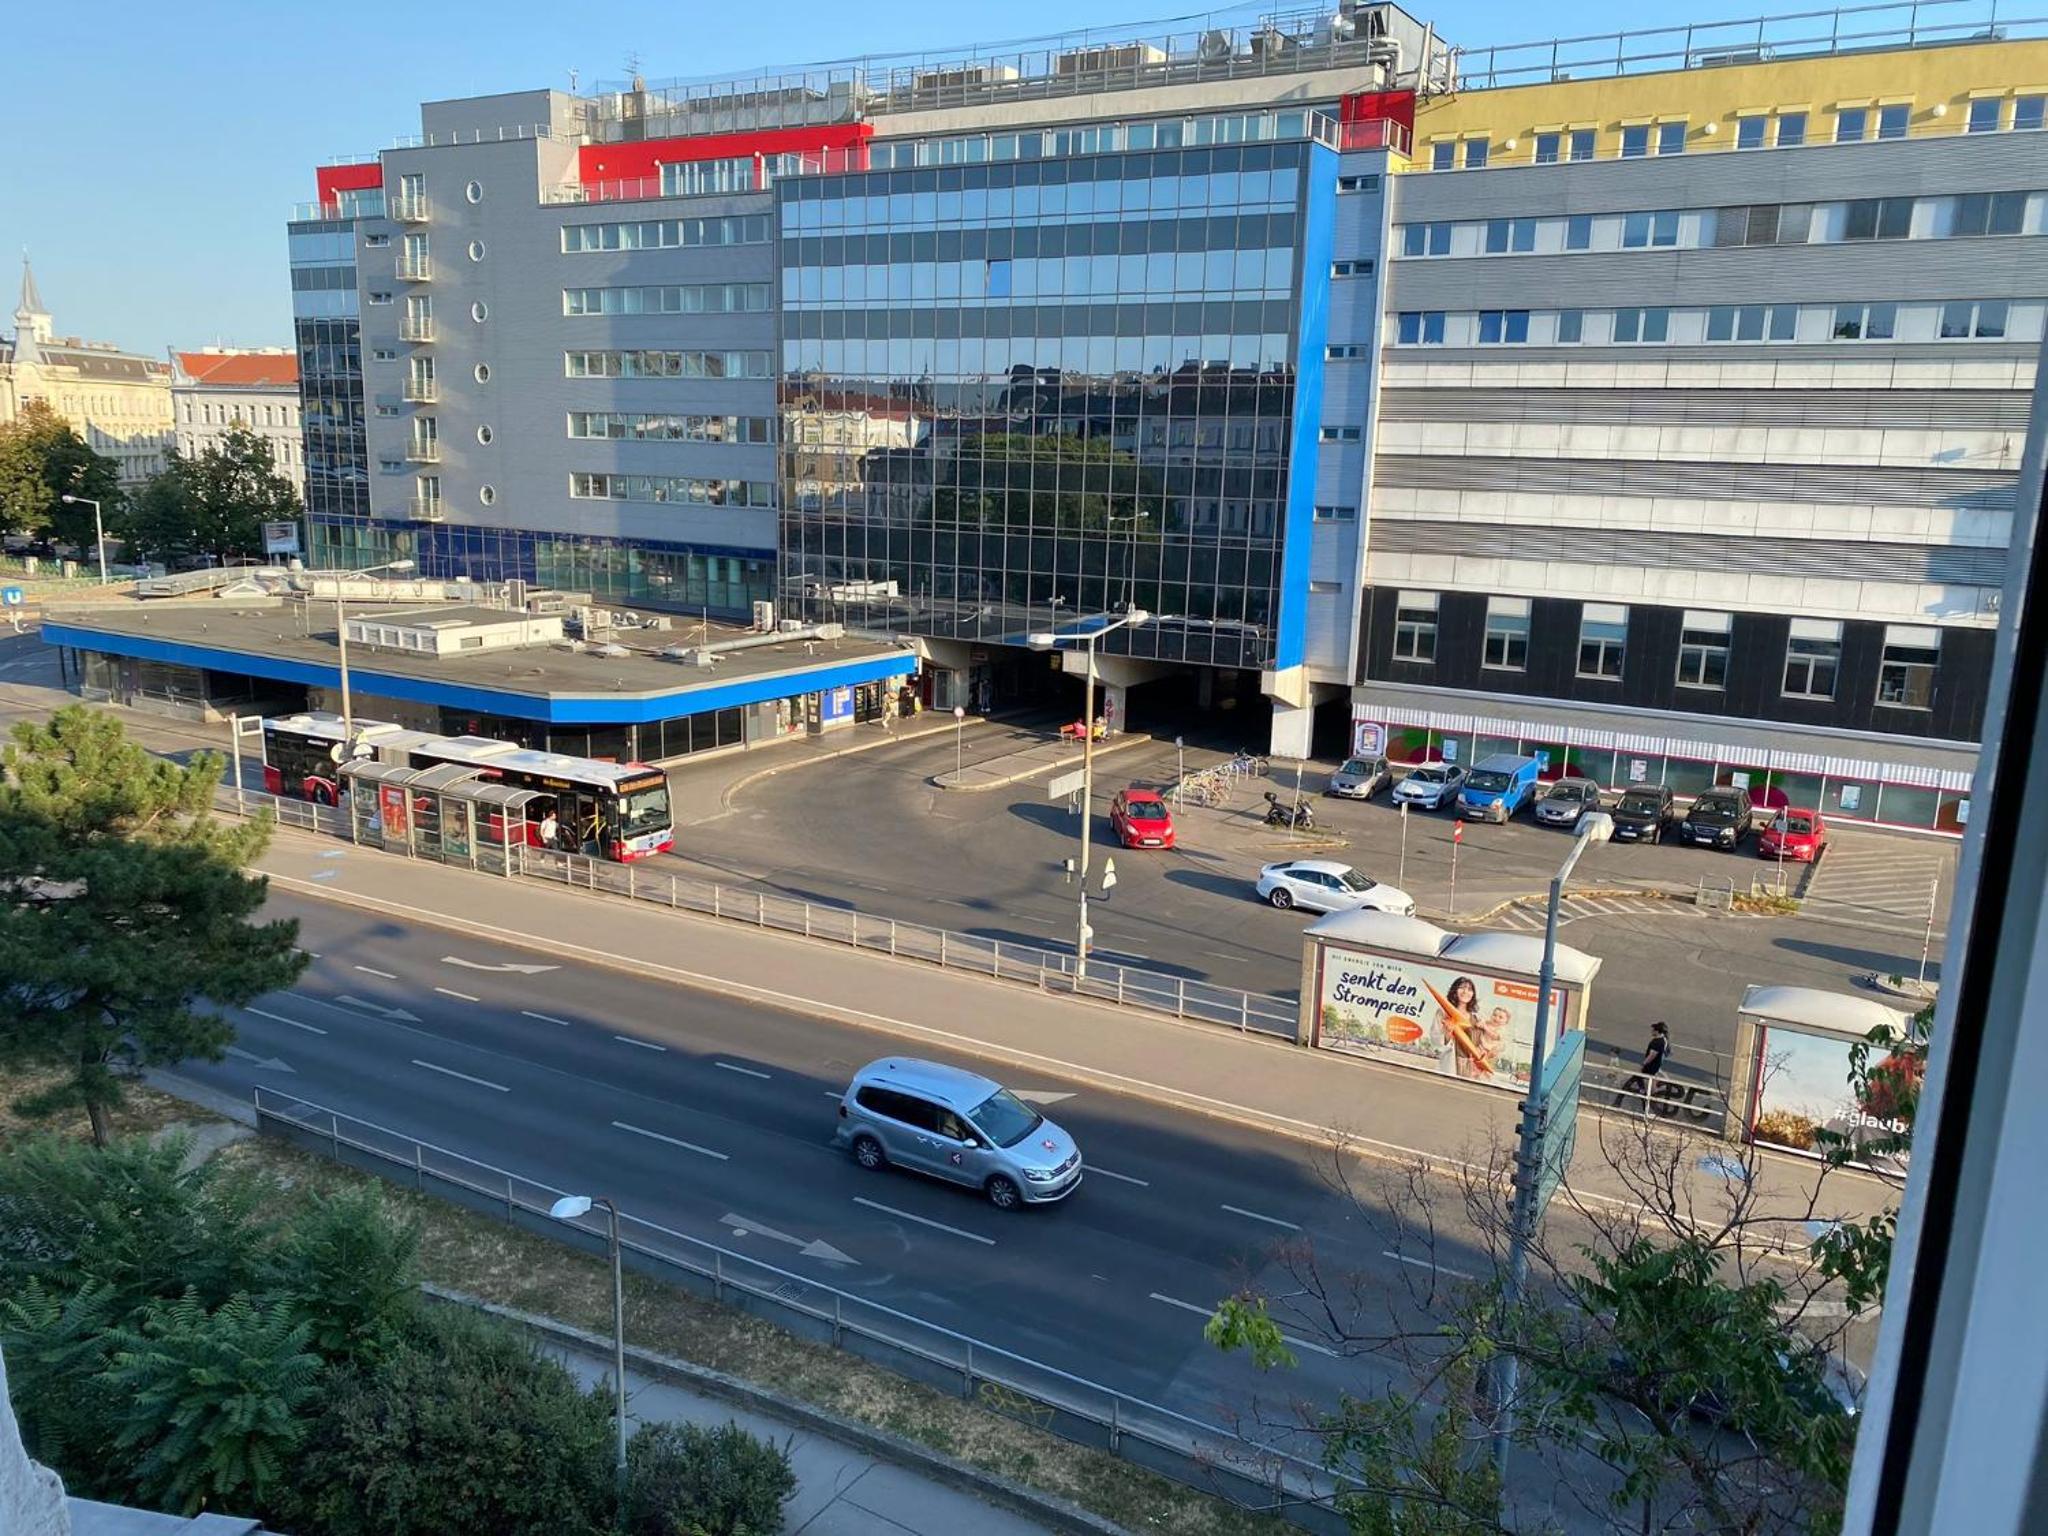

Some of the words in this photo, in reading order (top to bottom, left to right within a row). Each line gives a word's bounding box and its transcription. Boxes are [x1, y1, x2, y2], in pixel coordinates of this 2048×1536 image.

[7, 591, 21, 604] U
[1340, 970, 1387, 991] senkt
[1386, 977, 1417, 997] den
[1333, 983, 1425, 1018] Strompreis!
[1834, 1107, 1909, 1136] #glaub
